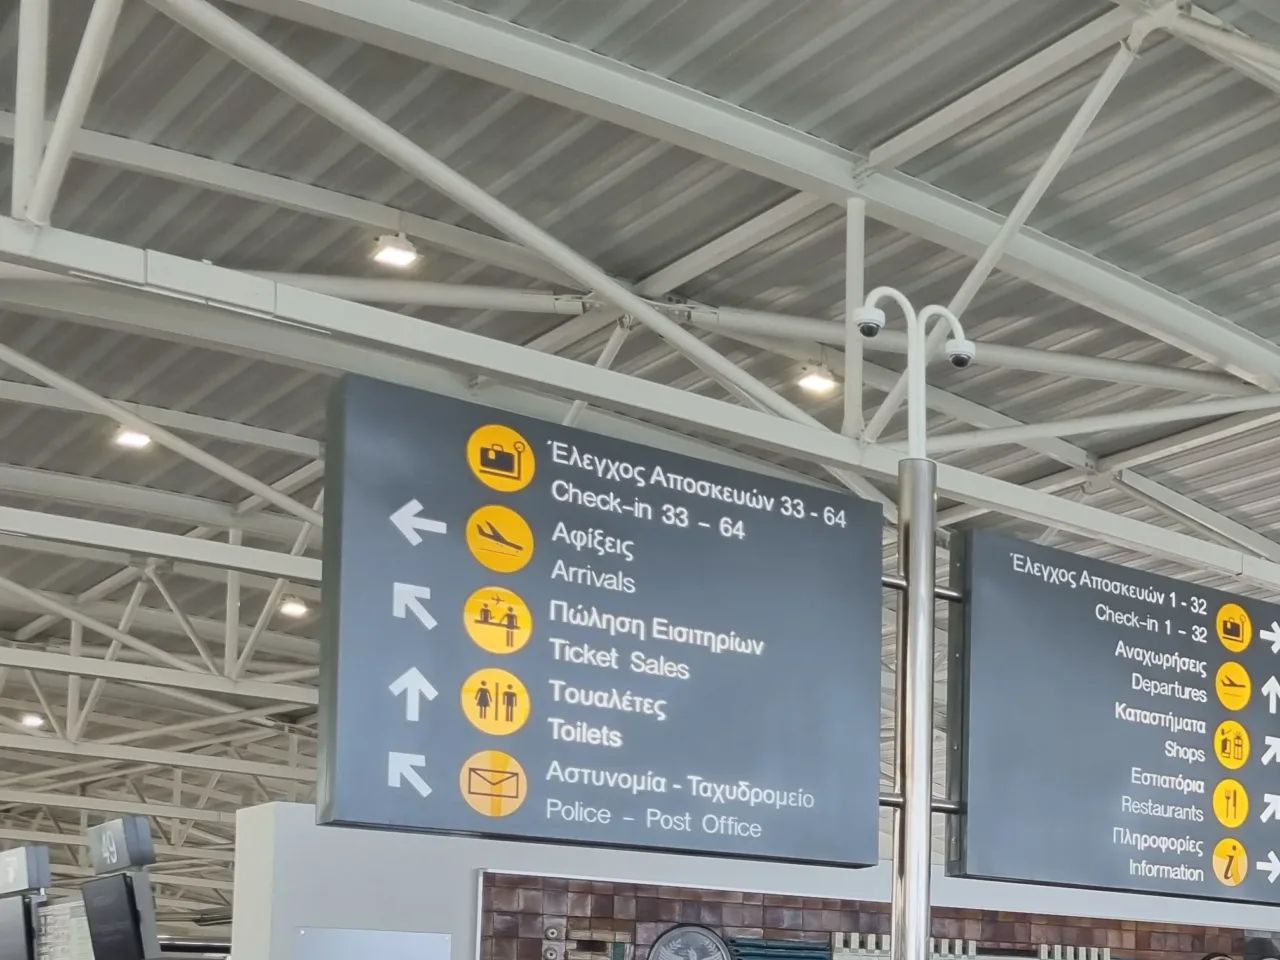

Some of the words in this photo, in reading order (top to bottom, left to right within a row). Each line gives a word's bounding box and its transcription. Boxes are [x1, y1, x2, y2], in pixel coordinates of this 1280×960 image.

[547, 441, 645, 487] Έλεγχος
[650, 466, 774, 511] Αποσκευών
[780, 496, 804, 518] 33
[824, 507, 846, 528] 64
[552, 480, 652, 520] Check-in
[662, 504, 688, 527] 33
[720, 517, 745, 539] 64
[552, 522, 634, 561] Αφίξεις
[551, 560, 635, 593] Arrivals
[1010, 553, 1076, 588] Έλεγχος
[1080, 569, 1164, 604] Αποσκευών
[1170, 592, 1175, 607] 1
[1191, 597, 1207, 615] 32
[550, 600, 645, 640] Πώληση
[653, 618, 764, 655] Εισιτηρίων
[1096, 604, 1158, 632] Check-in
[1165, 620, 1170, 635] 1
[1192, 625, 1207, 643] 32
[549, 638, 619, 669] Ticket
[631, 651, 690, 679] Sales
[1115, 641, 1207, 678] Αναχωρήσεις
[549, 680, 667, 721] Τουαλέτες
[1132, 673, 1207, 702] Departures
[548, 718, 622, 747] Toilets
[1116, 702, 1206, 733] Καταστήματα
[1165, 741, 1205, 763] Shops
[546, 760, 666, 794] Αστυνομία
[687, 776, 814, 809] Ταχυδρομείο
[1132, 767, 1204, 794] Εστιατόρια
[547, 799, 611, 823] Police
[647, 808, 692, 831] Post
[702, 814, 761, 837] Office
[1122, 796, 1203, 821] Restaurants
[102, 831, 118, 864] 49
[1113, 827, 1203, 857] Πληροφορίες
[5, 856, 18, 885] 7
[1130, 859, 1203, 881] Information
